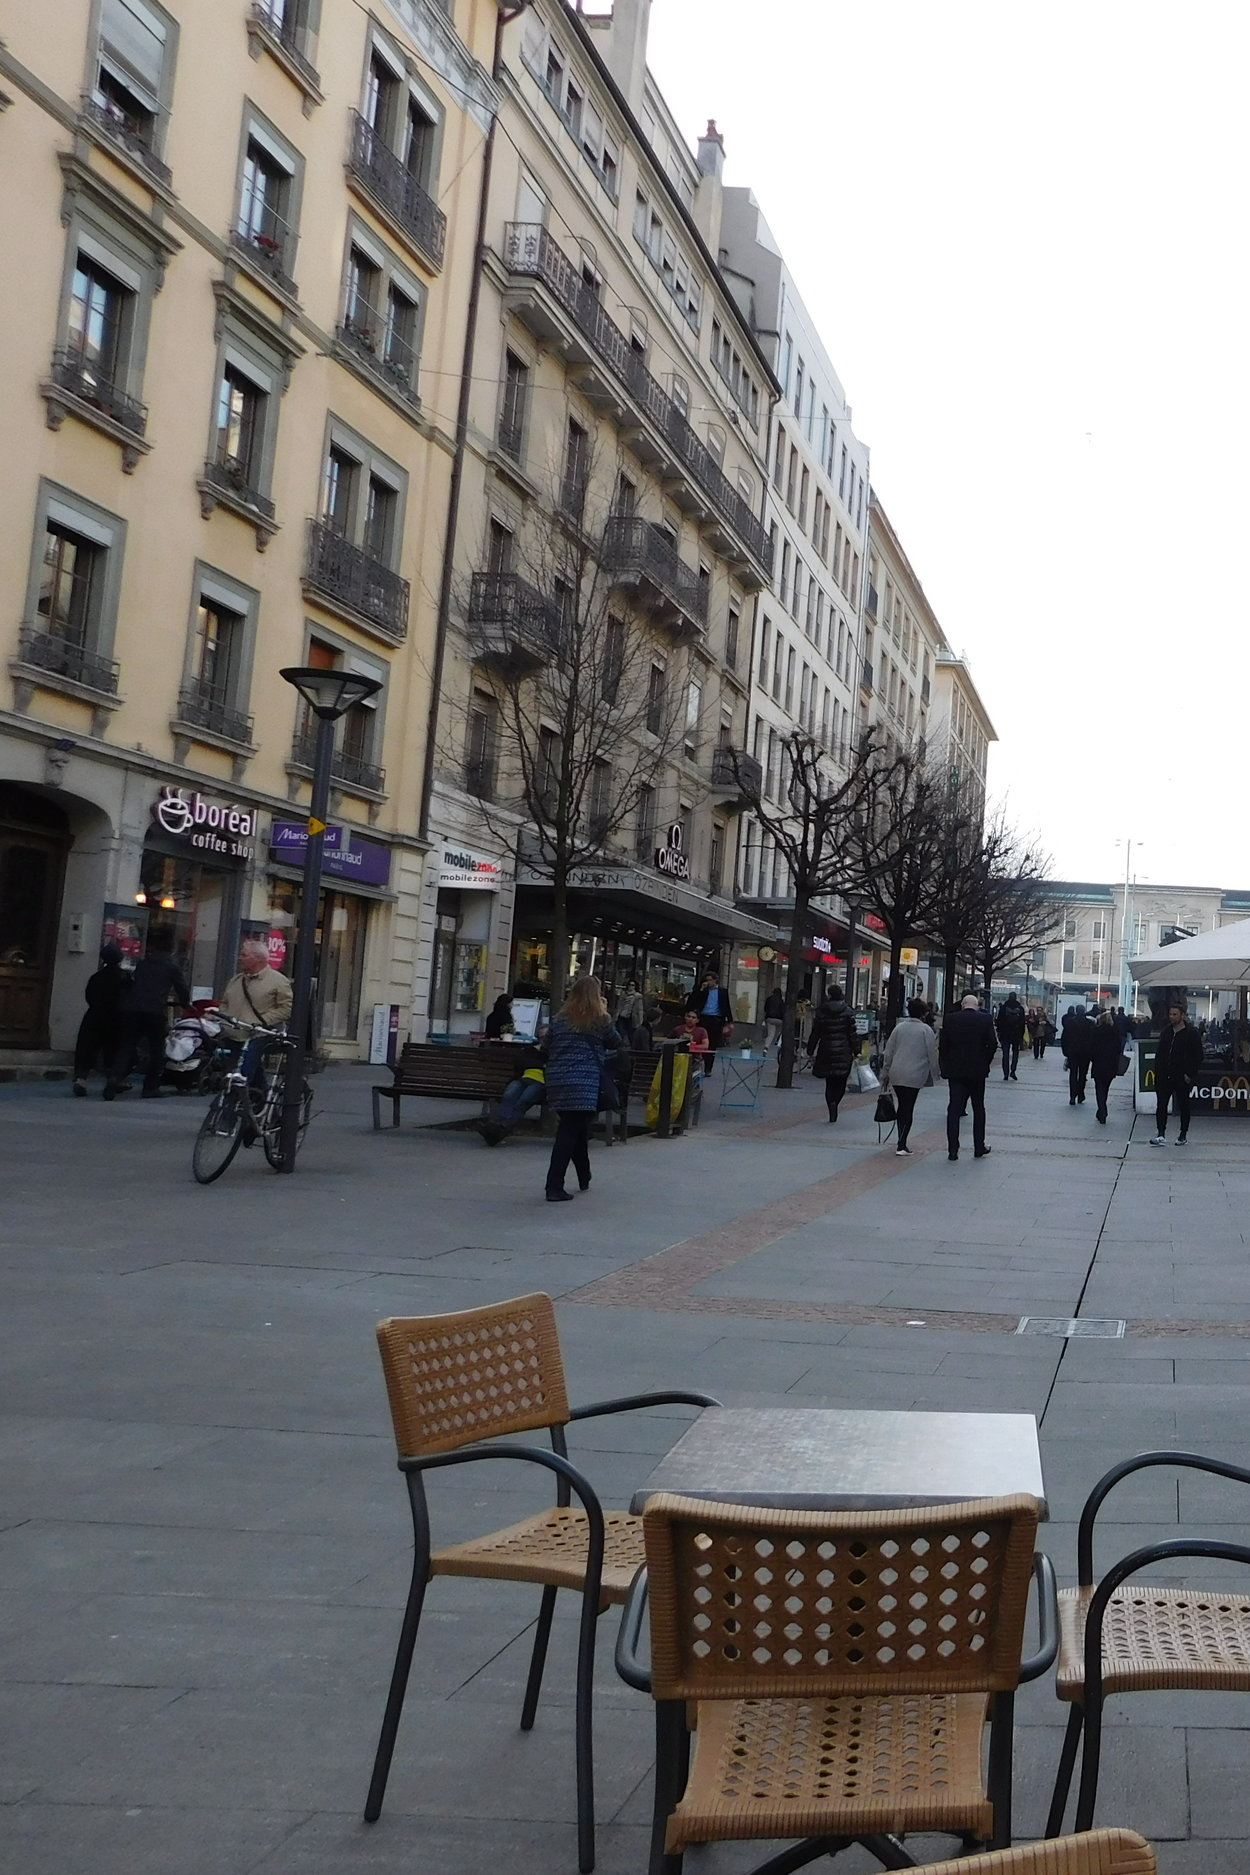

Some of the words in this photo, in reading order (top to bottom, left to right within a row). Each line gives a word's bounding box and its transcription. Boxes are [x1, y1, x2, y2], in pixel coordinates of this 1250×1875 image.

[194, 792, 258, 837] boréal
[192, 832, 227, 853] coffee
[231, 840, 254, 862] shop
[440, 873, 496, 883] mobilezone
[658, 847, 690, 880] OMEGA
